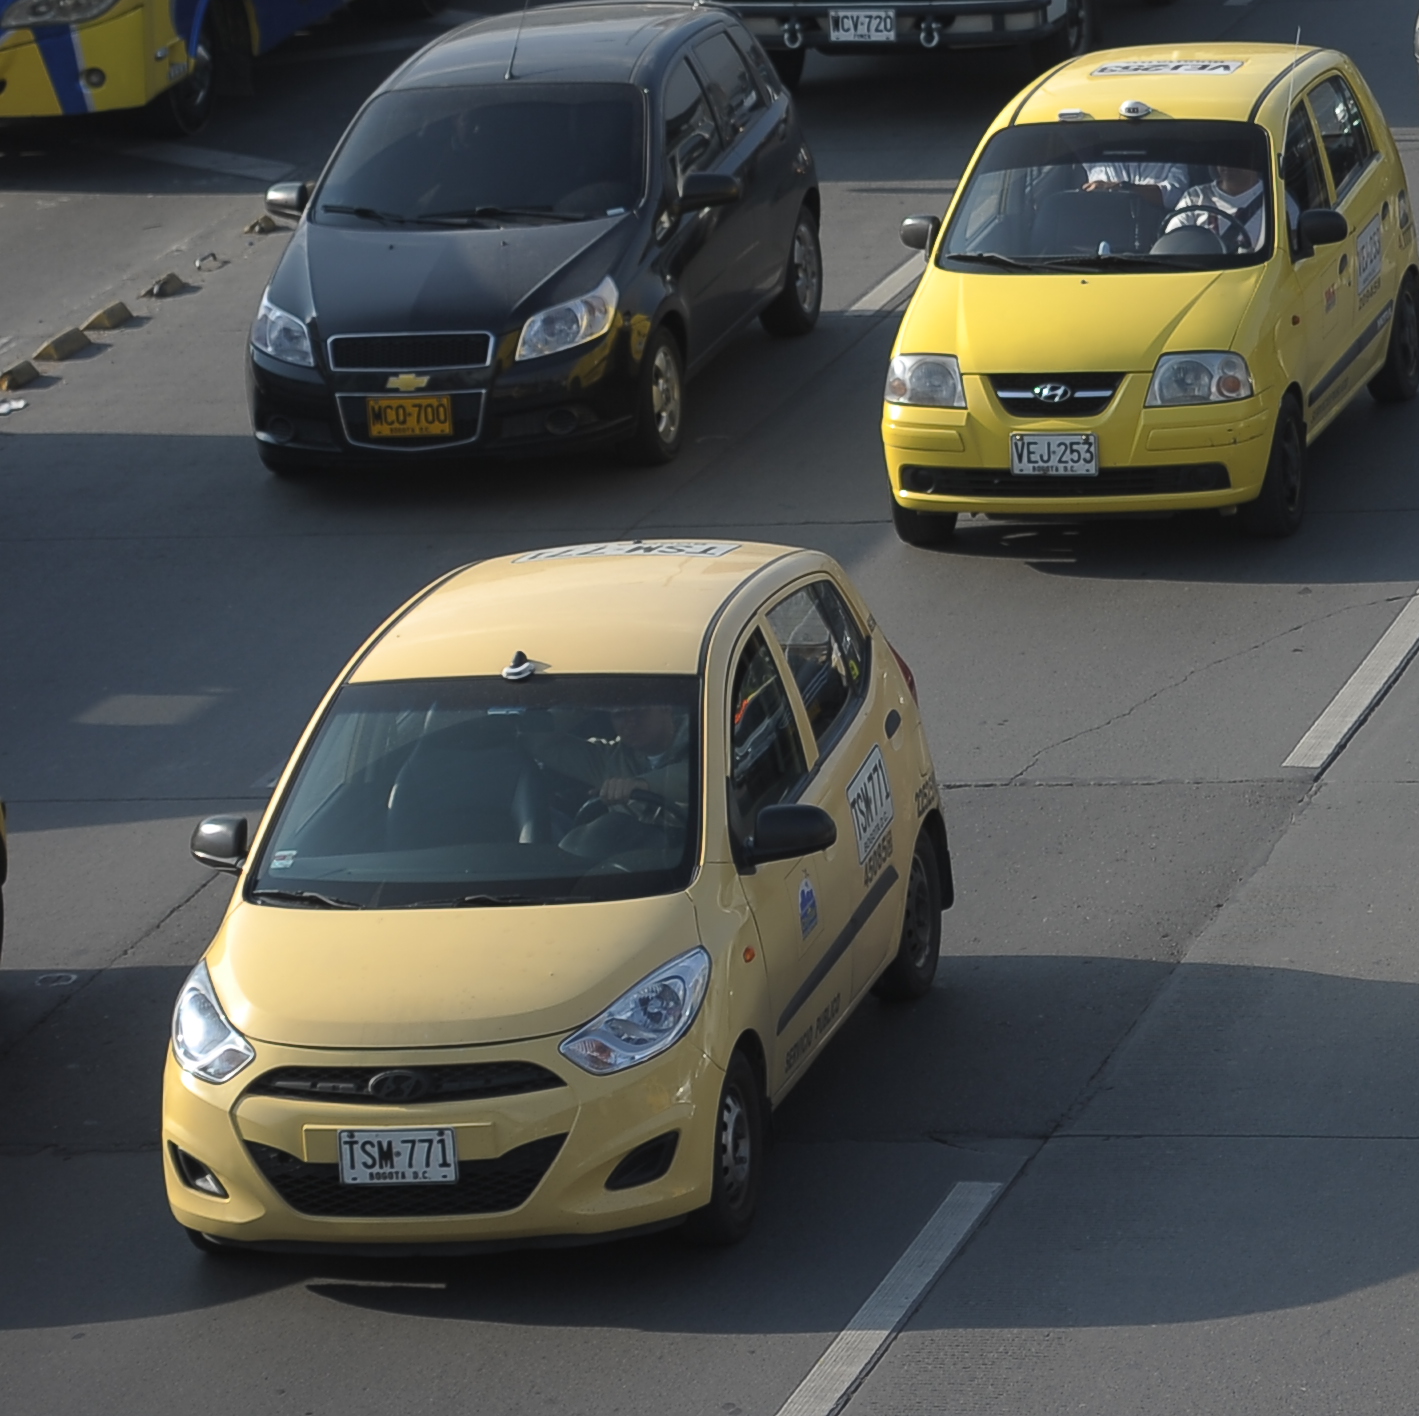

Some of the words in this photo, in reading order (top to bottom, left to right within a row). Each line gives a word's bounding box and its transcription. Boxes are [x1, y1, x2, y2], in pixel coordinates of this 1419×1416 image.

[830, 14, 895, 34] WCV-720
[1013, 441, 1095, 465] VEJ-253
[850, 757, 891, 842] TSM-771
[342, 1136, 452, 1172] TSM-771
[368, 1171, 407, 1181] BOGOTA
